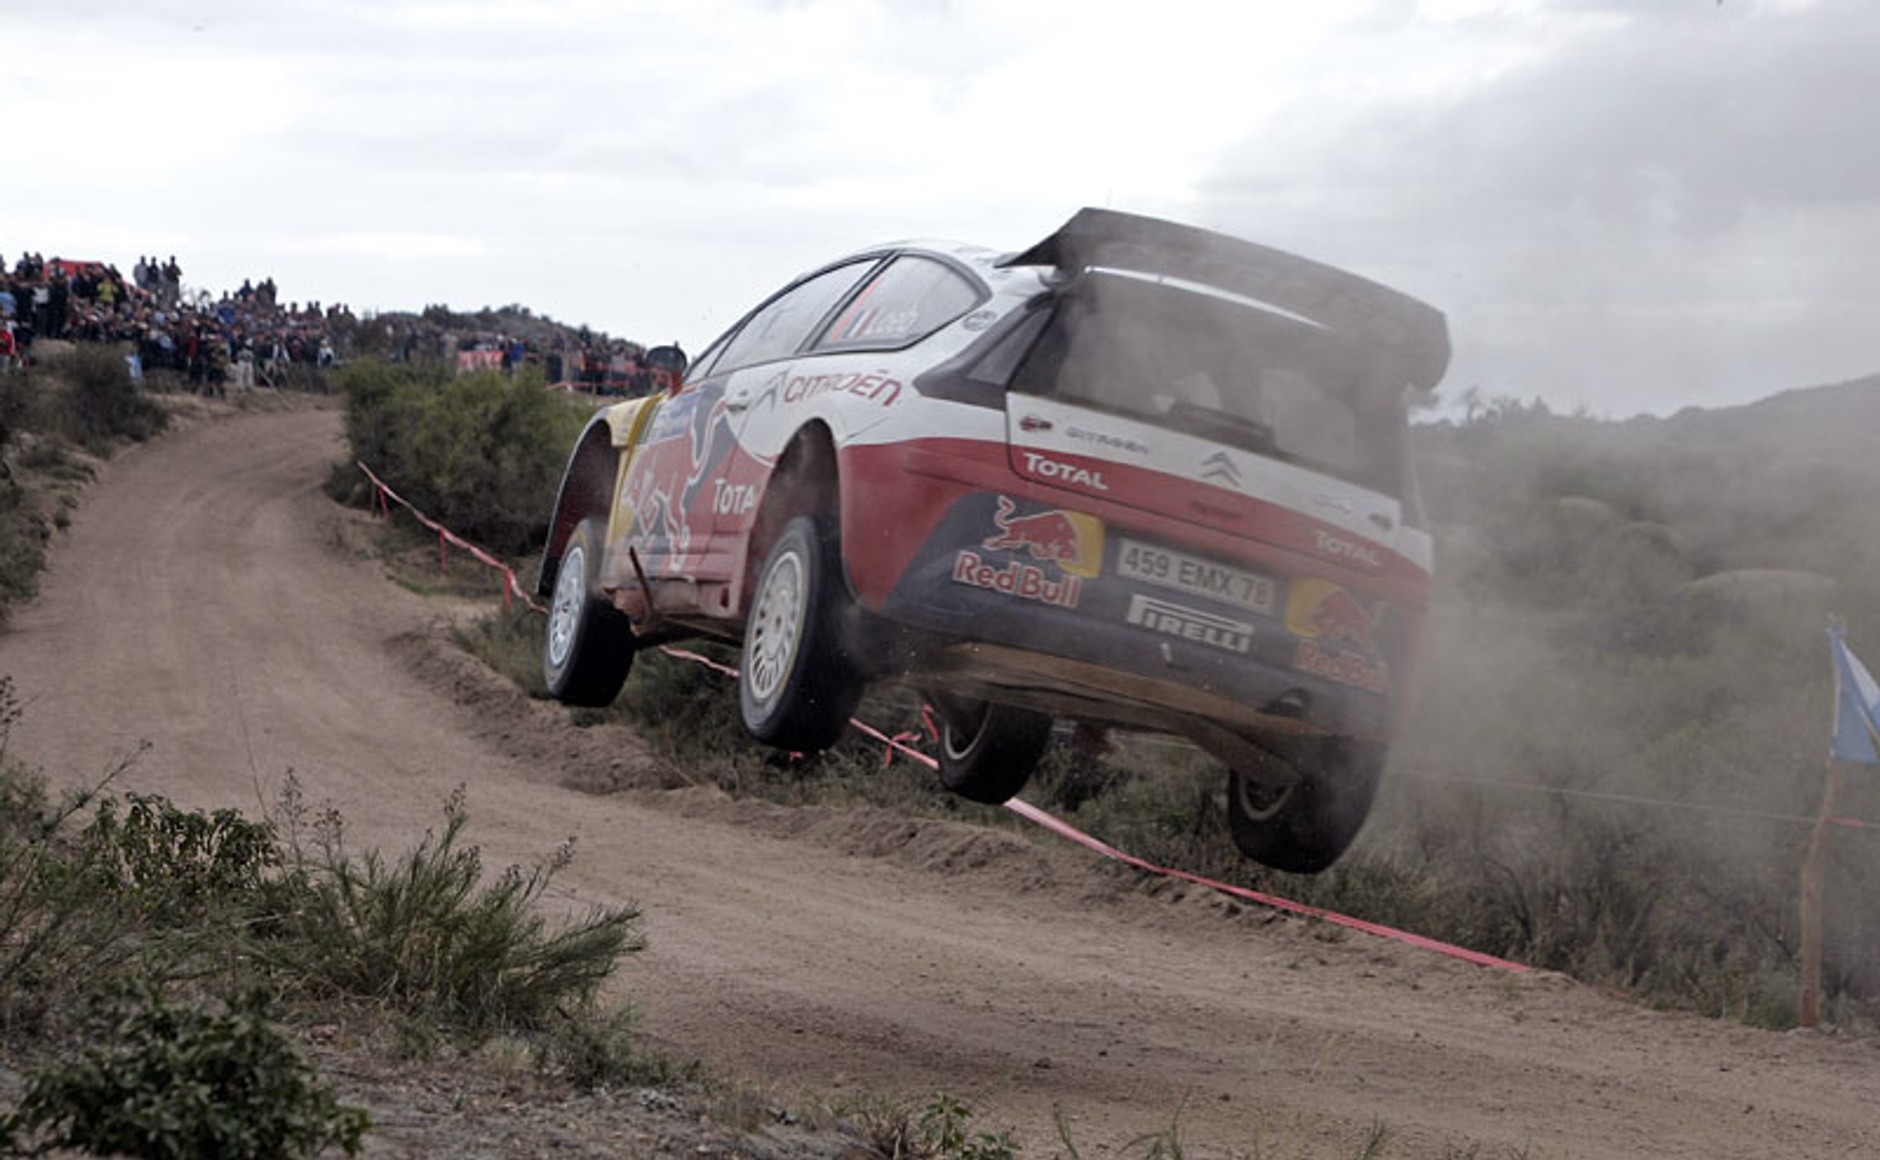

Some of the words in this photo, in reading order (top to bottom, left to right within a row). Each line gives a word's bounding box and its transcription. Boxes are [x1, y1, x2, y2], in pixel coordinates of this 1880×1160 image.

[1022, 452, 1109, 490] TOTAL
[712, 477, 755, 517] TOTA
[1312, 528, 1382, 567] TOTAL
[952, 549, 1020, 594] Red
[1018, 565, 1081, 611] Bull
[1125, 547, 1170, 578] 459
[1179, 560, 1234, 597] EMX
[1126, 593, 1255, 653] PIRELLI
